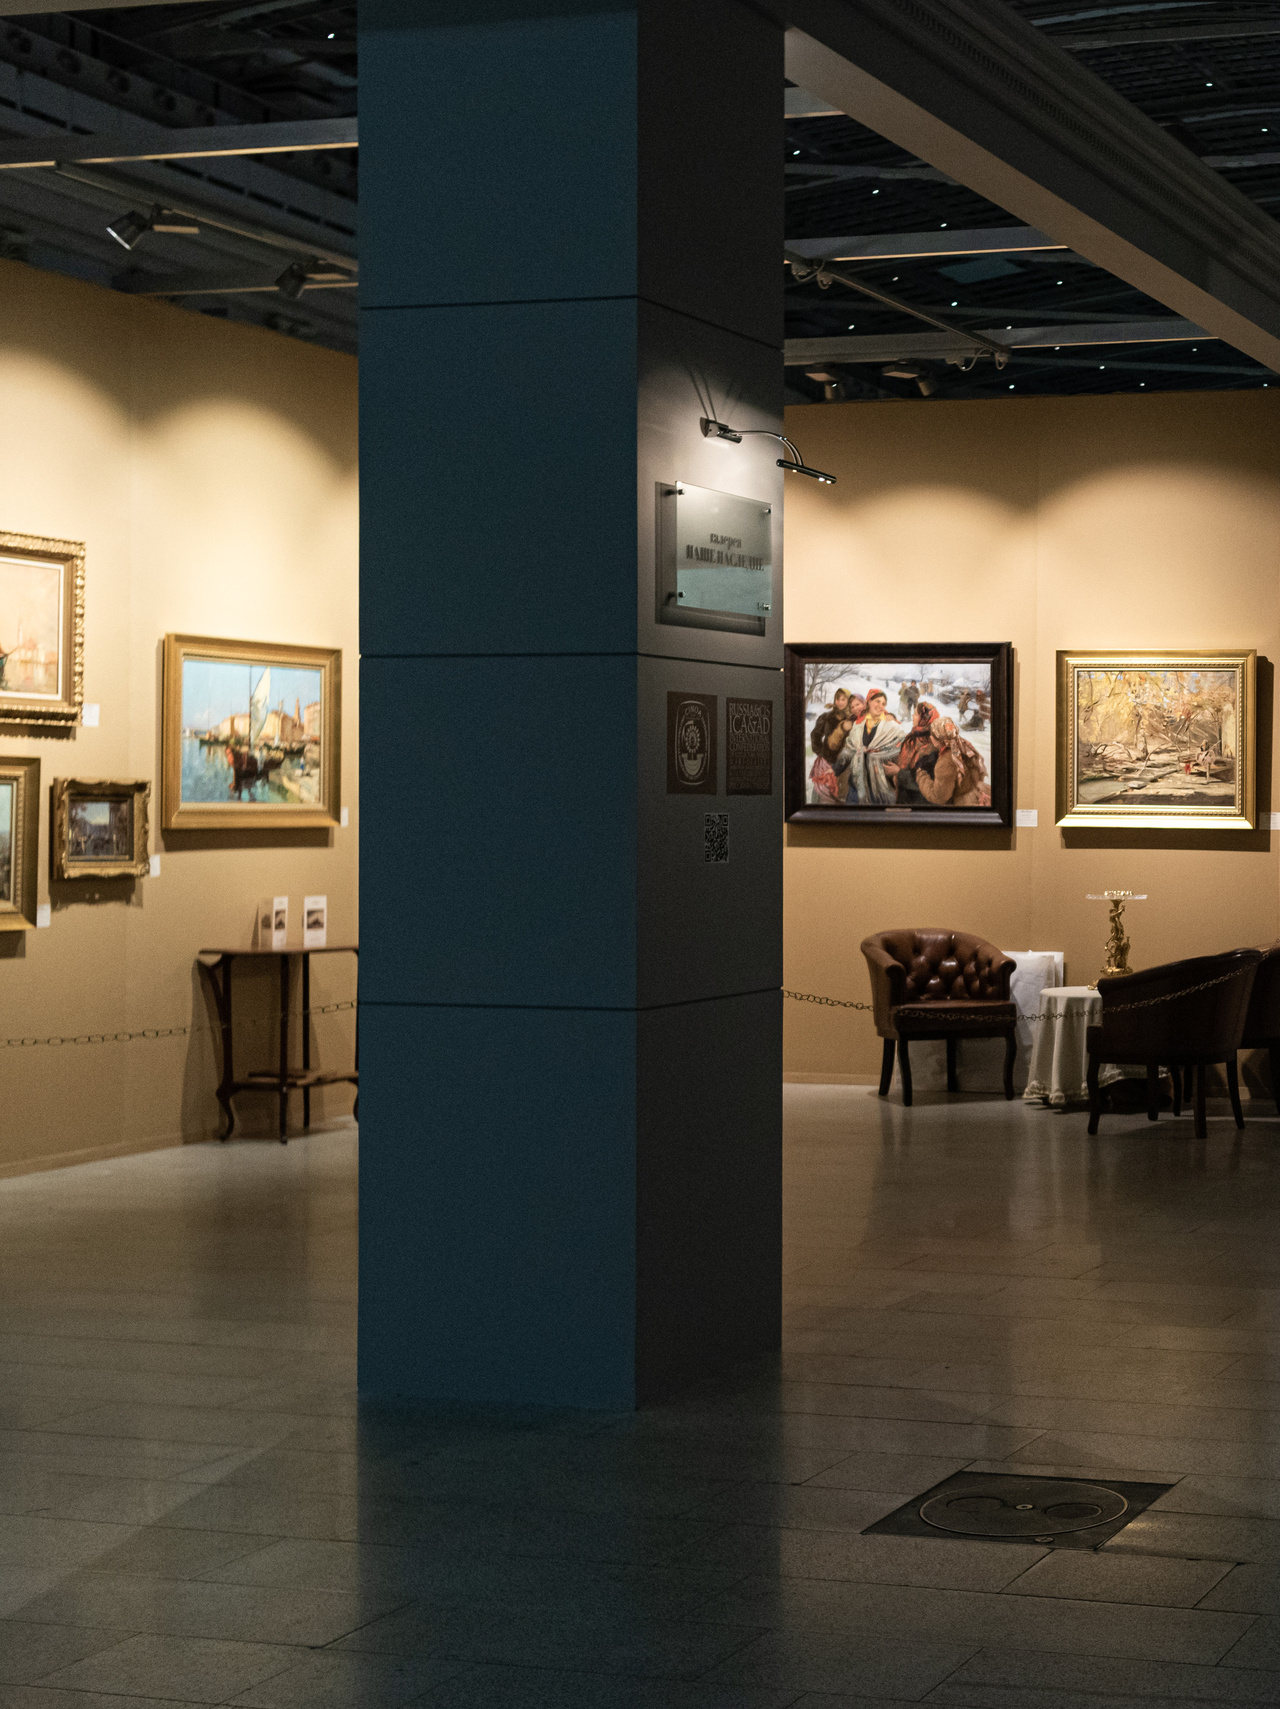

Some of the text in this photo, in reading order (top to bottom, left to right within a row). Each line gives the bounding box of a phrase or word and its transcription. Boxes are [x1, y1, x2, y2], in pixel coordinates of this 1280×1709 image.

[710, 533, 742, 550] галерея
[686, 544, 764, 571] НАШЕ НАСЛЕДИЕ
[685, 705, 702, 717] CINOA
[729, 715, 770, 735] ICA&AD
